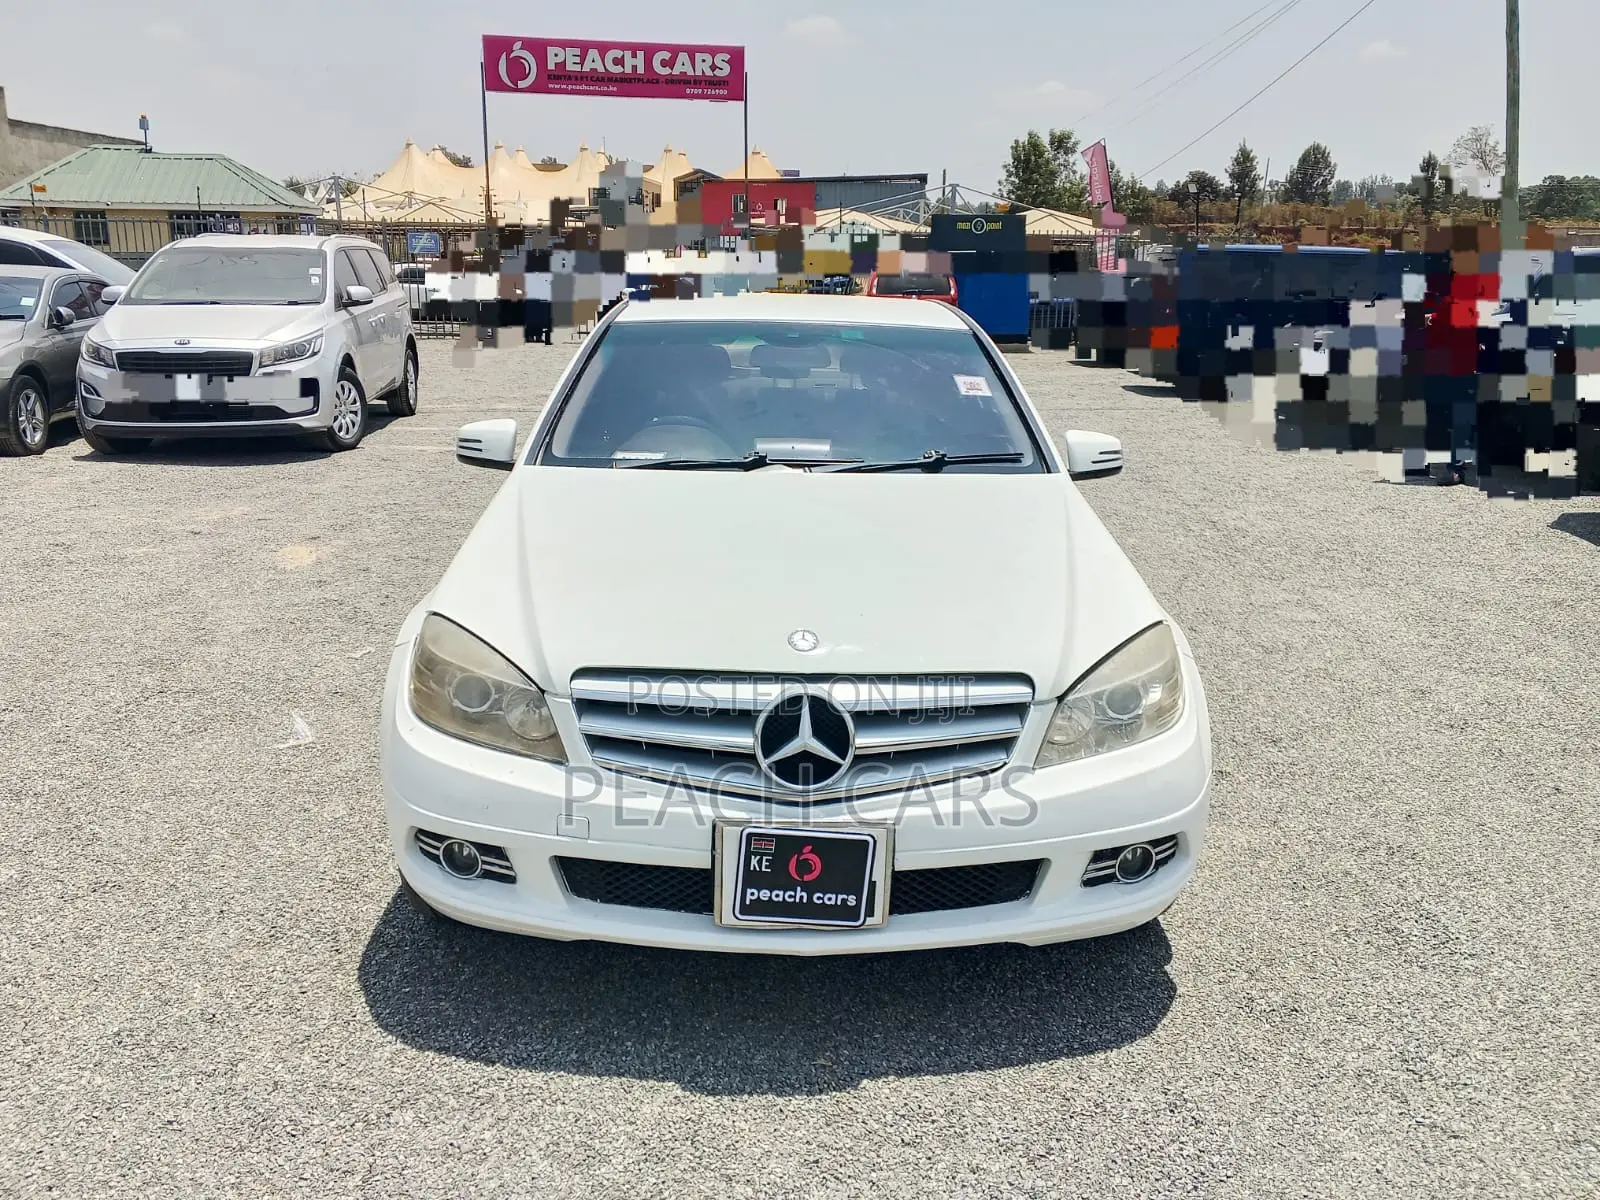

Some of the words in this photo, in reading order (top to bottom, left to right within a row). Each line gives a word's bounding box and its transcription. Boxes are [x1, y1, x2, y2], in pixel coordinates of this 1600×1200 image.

[546, 46, 646, 74] PEACH
[652, 50, 731, 77] CARS
[548, 83, 618, 92] www.peachcars.co.ke
[607, 77, 660, 85] MARKETPLACE
[750, 855, 773, 872] KE
[746, 887, 807, 904] peach
[812, 893, 857, 906] cars
